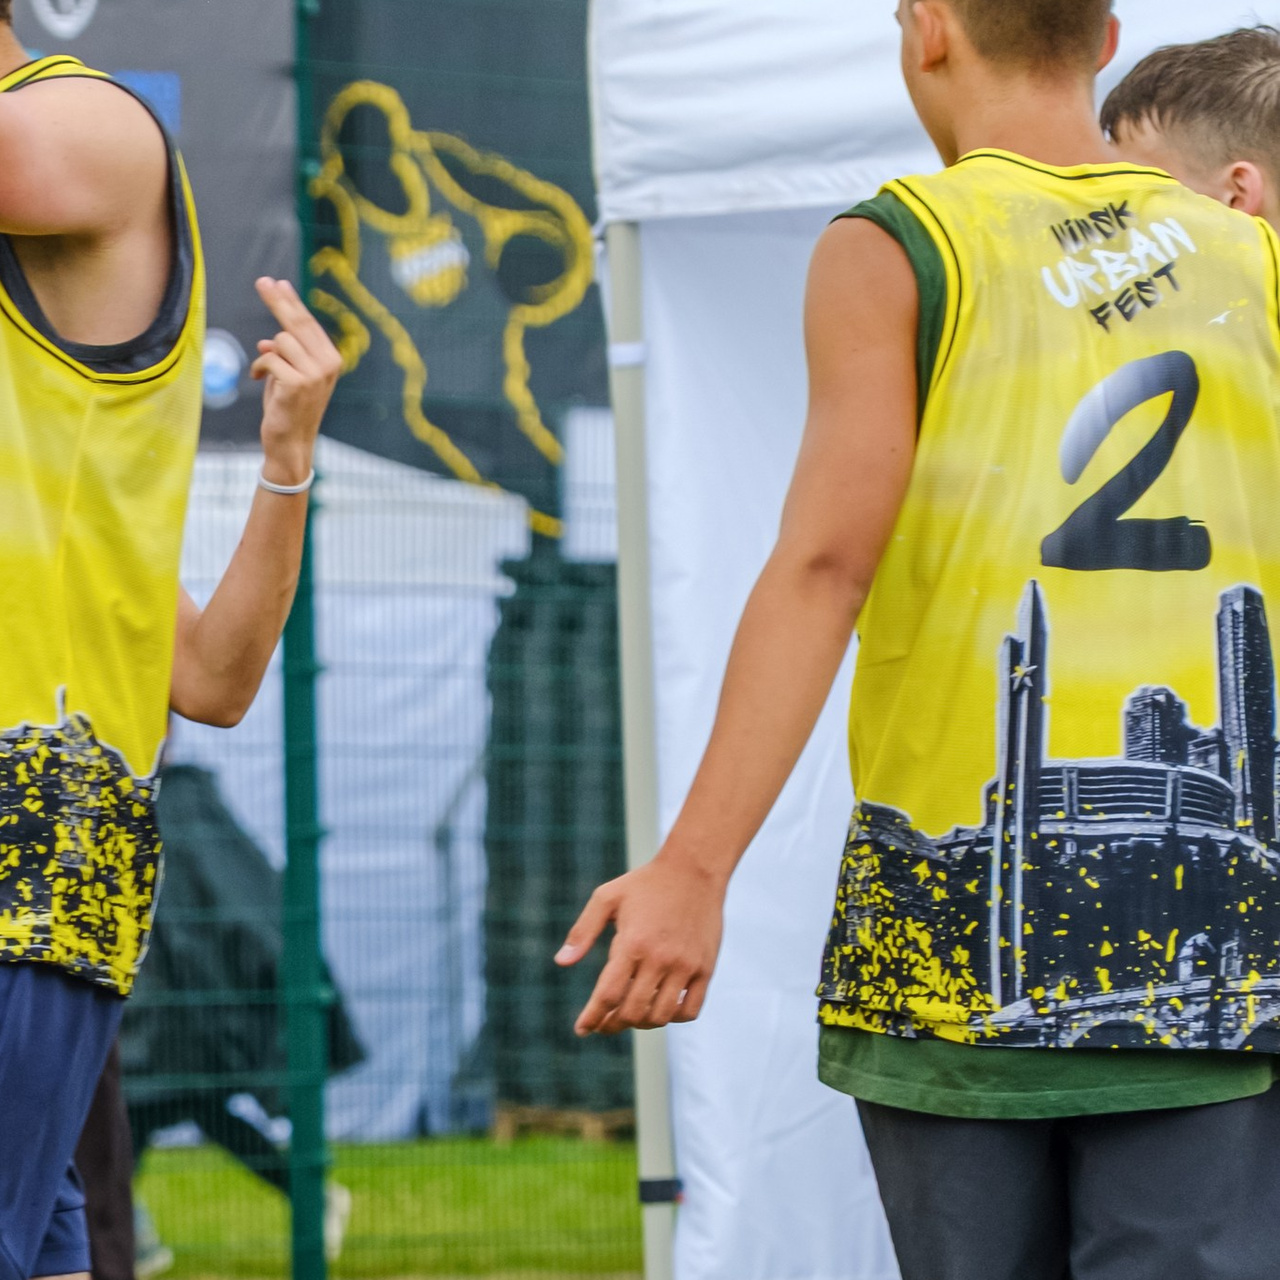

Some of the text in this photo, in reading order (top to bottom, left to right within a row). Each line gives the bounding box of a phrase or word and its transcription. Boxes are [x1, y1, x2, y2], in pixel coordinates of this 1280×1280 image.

[1040, 217, 1197, 308] URBAN
[1089, 261, 1180, 334] FEST
[1041, 350, 1211, 571] 2
